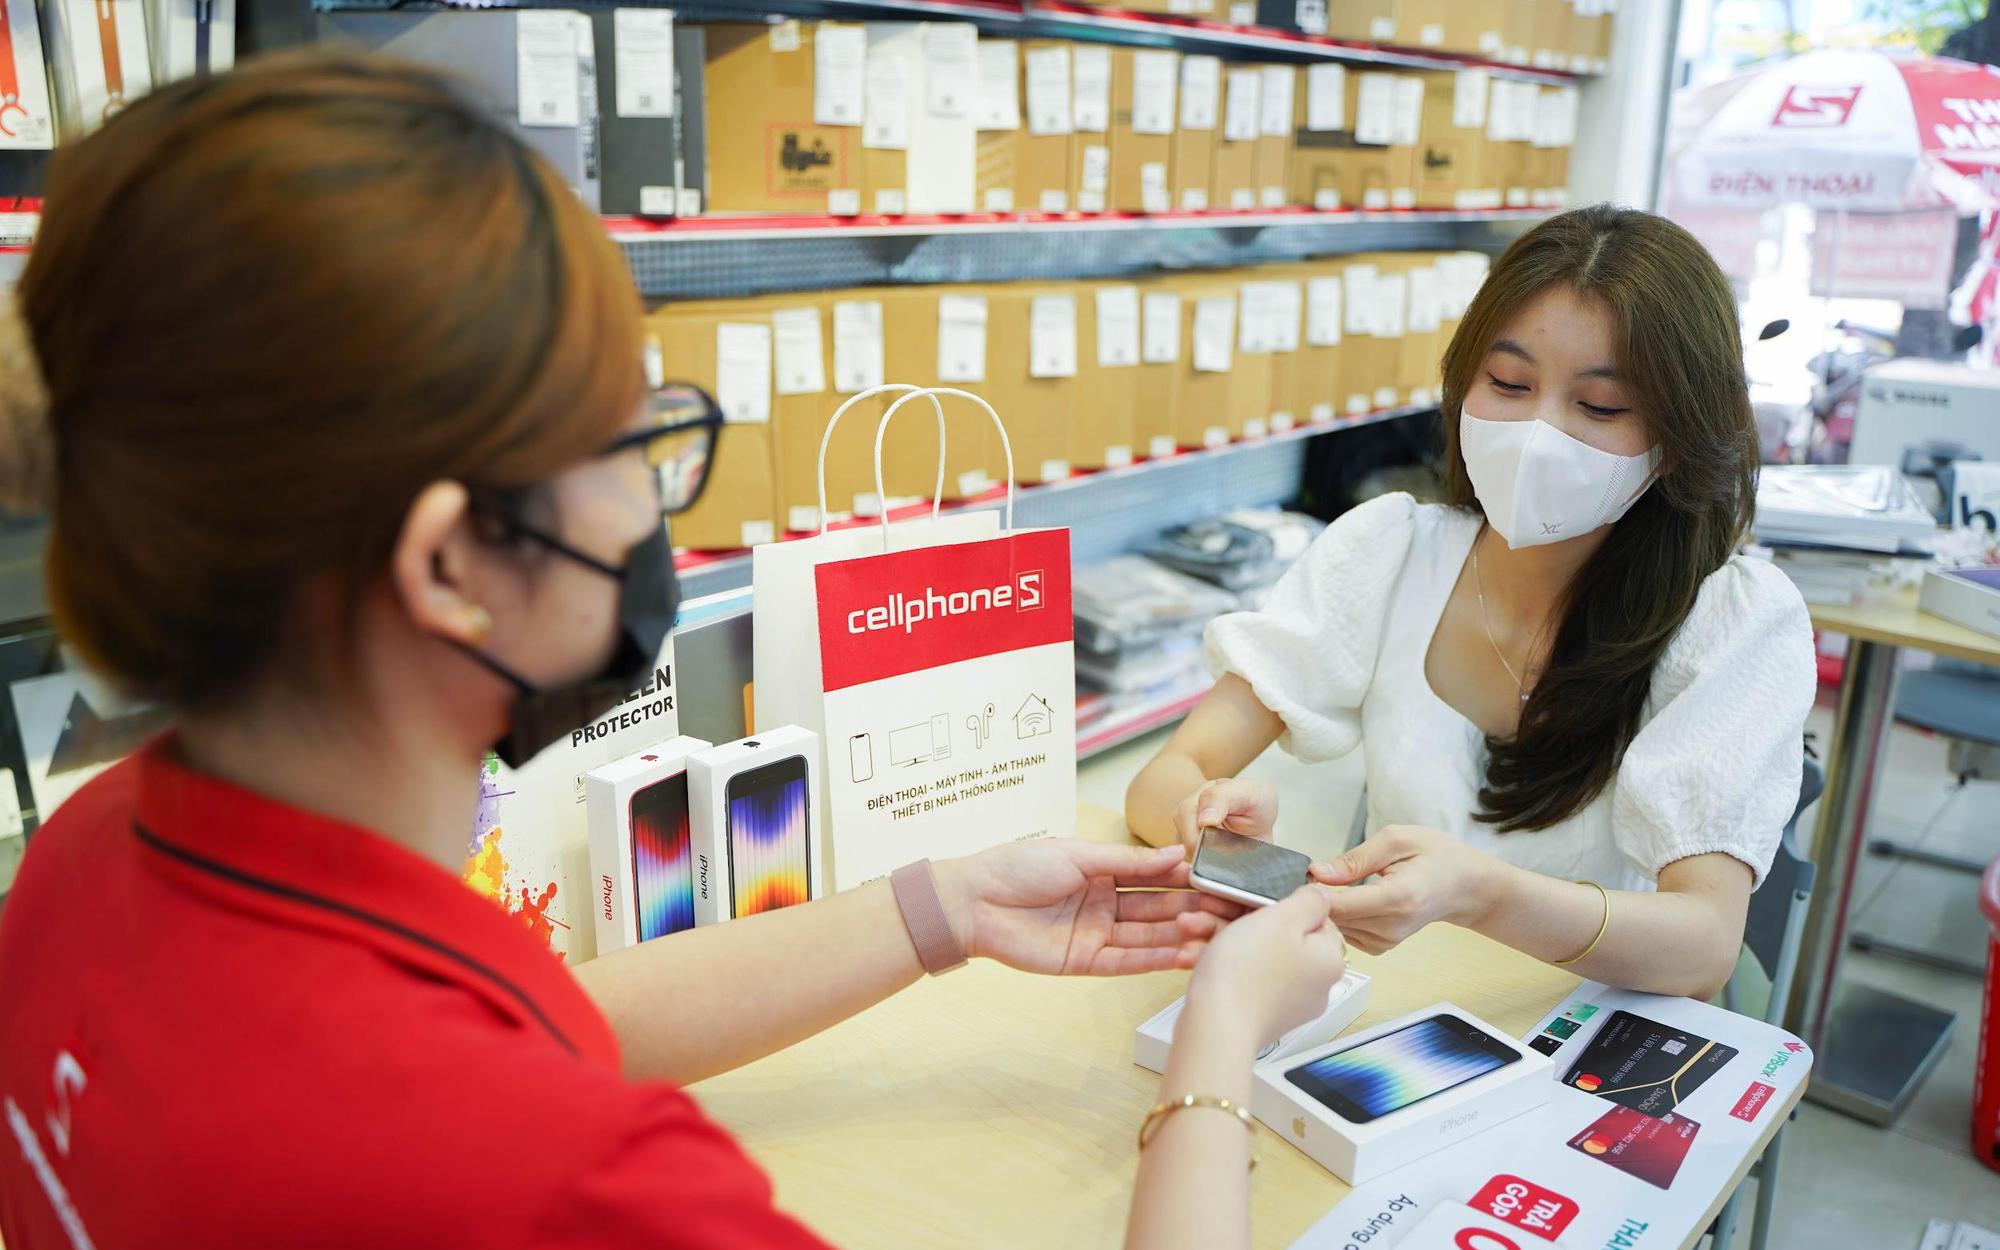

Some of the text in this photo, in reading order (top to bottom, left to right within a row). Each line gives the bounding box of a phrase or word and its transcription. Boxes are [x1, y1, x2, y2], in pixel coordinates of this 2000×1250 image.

[571, 695, 674, 748] PROTECTOR
[867, 794, 893, 810] ĐIỆN
[895, 783, 928, 800] THOẠI
[935, 774, 957, 791] MÁY
[959, 767, 983, 784] TÍNH
[991, 761, 1008, 775] ÂM
[1010, 753, 1046, 770] THANH
[891, 774, 1025, 821] THIẾT BỊ NHÀ THÔNG MINH
[602, 875, 613, 921] iPhone
[699, 854, 708, 900] iPhone
[1761, 1050, 1793, 1078] VPBank
[1638, 1087, 1666, 1110] DIAMOND
[1439, 1110, 1479, 1134] iPhone
[1351, 1193, 1418, 1243] Áp dụng
[1489, 1182, 1529, 1218] GÓP
[1520, 1198, 1563, 1232] TRẢ
